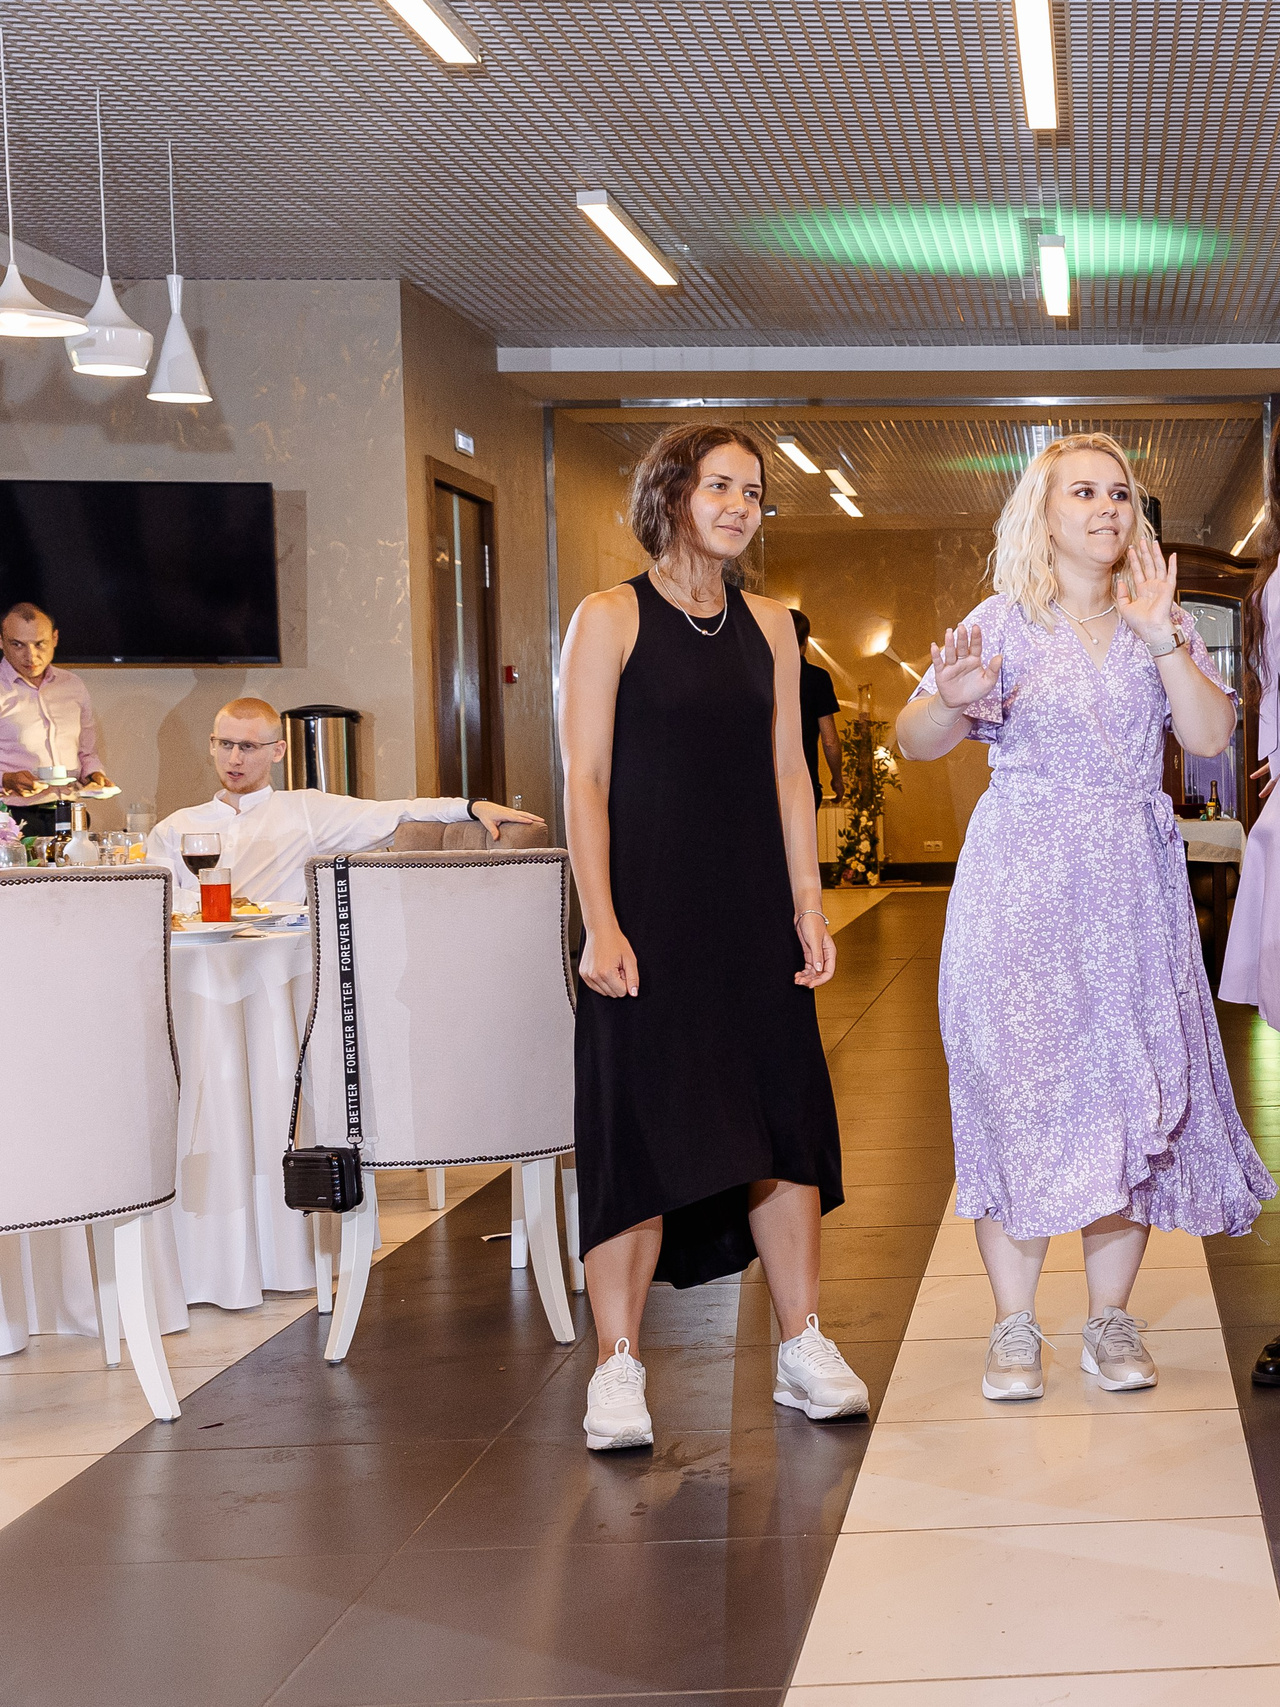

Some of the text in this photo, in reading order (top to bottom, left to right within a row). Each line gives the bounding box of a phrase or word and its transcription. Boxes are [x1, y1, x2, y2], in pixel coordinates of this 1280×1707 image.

[337, 879, 348, 919] BETTER
[340, 922, 351, 972] FOREVER
[342, 981, 353, 1022] BETTER
[345, 1025, 356, 1074] FOREVER
[347, 1083, 358, 1124] BETTER
